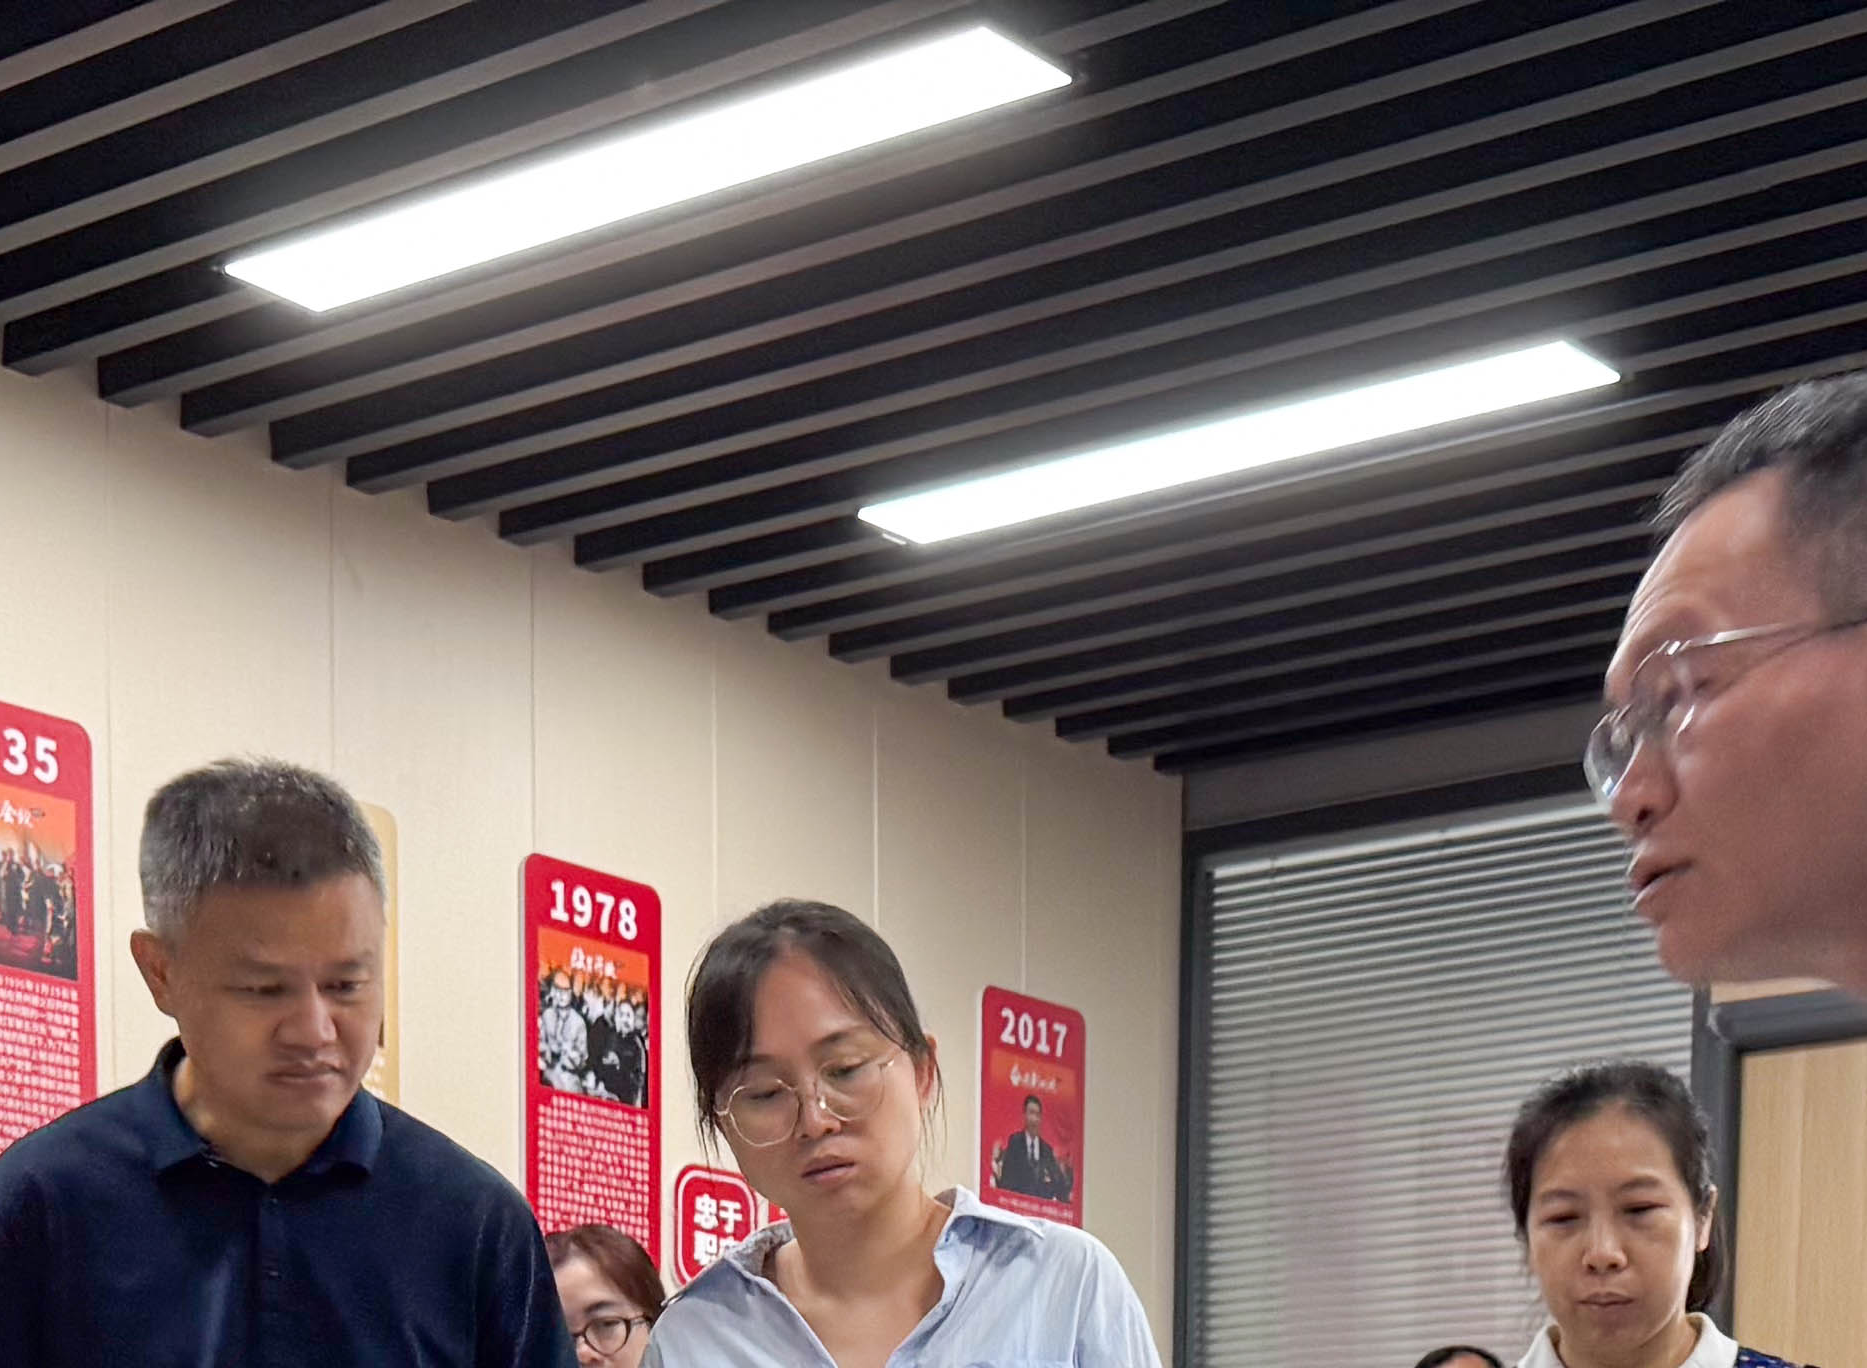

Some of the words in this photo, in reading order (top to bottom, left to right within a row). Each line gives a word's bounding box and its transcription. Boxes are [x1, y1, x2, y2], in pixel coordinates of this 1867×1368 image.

[550, 879, 638, 940] 1978
[1000, 1007, 1068, 1059] 2017
[694, 1194, 743, 1234] 忠于
